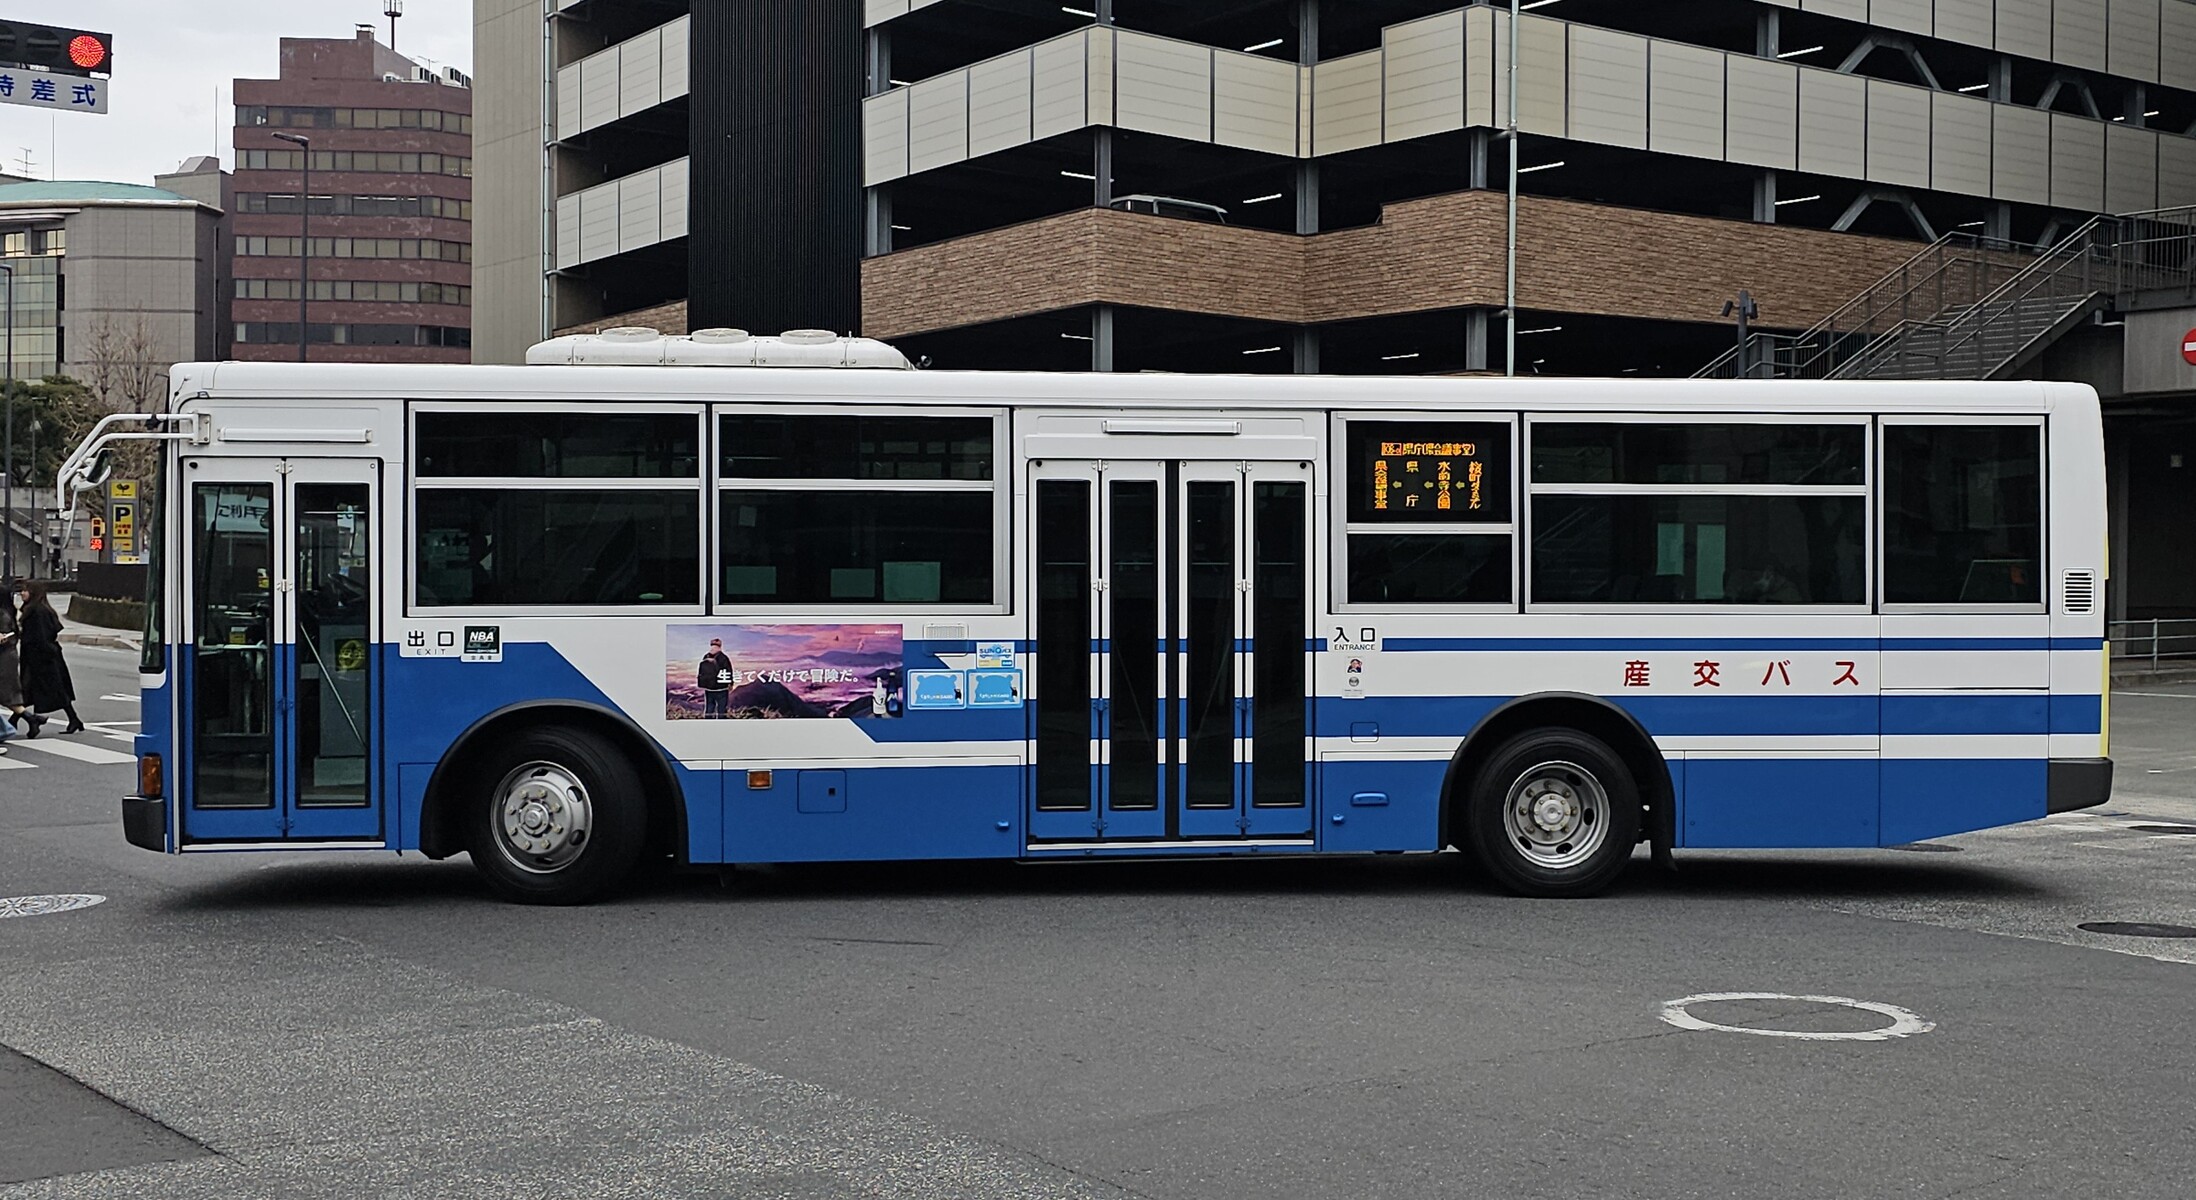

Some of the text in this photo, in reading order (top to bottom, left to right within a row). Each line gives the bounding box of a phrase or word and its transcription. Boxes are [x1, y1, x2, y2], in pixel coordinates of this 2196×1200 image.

[115, 507, 131, 522] P
[407, 630, 455, 647] 出口
[469, 631, 495, 642] NBA
[1333, 626, 1376, 643] 入口
[416, 648, 446, 656] EXIT
[716, 668, 859, 683] 生きてくだけで冒険だ。
[1623, 659, 1859, 687] 産交バス
